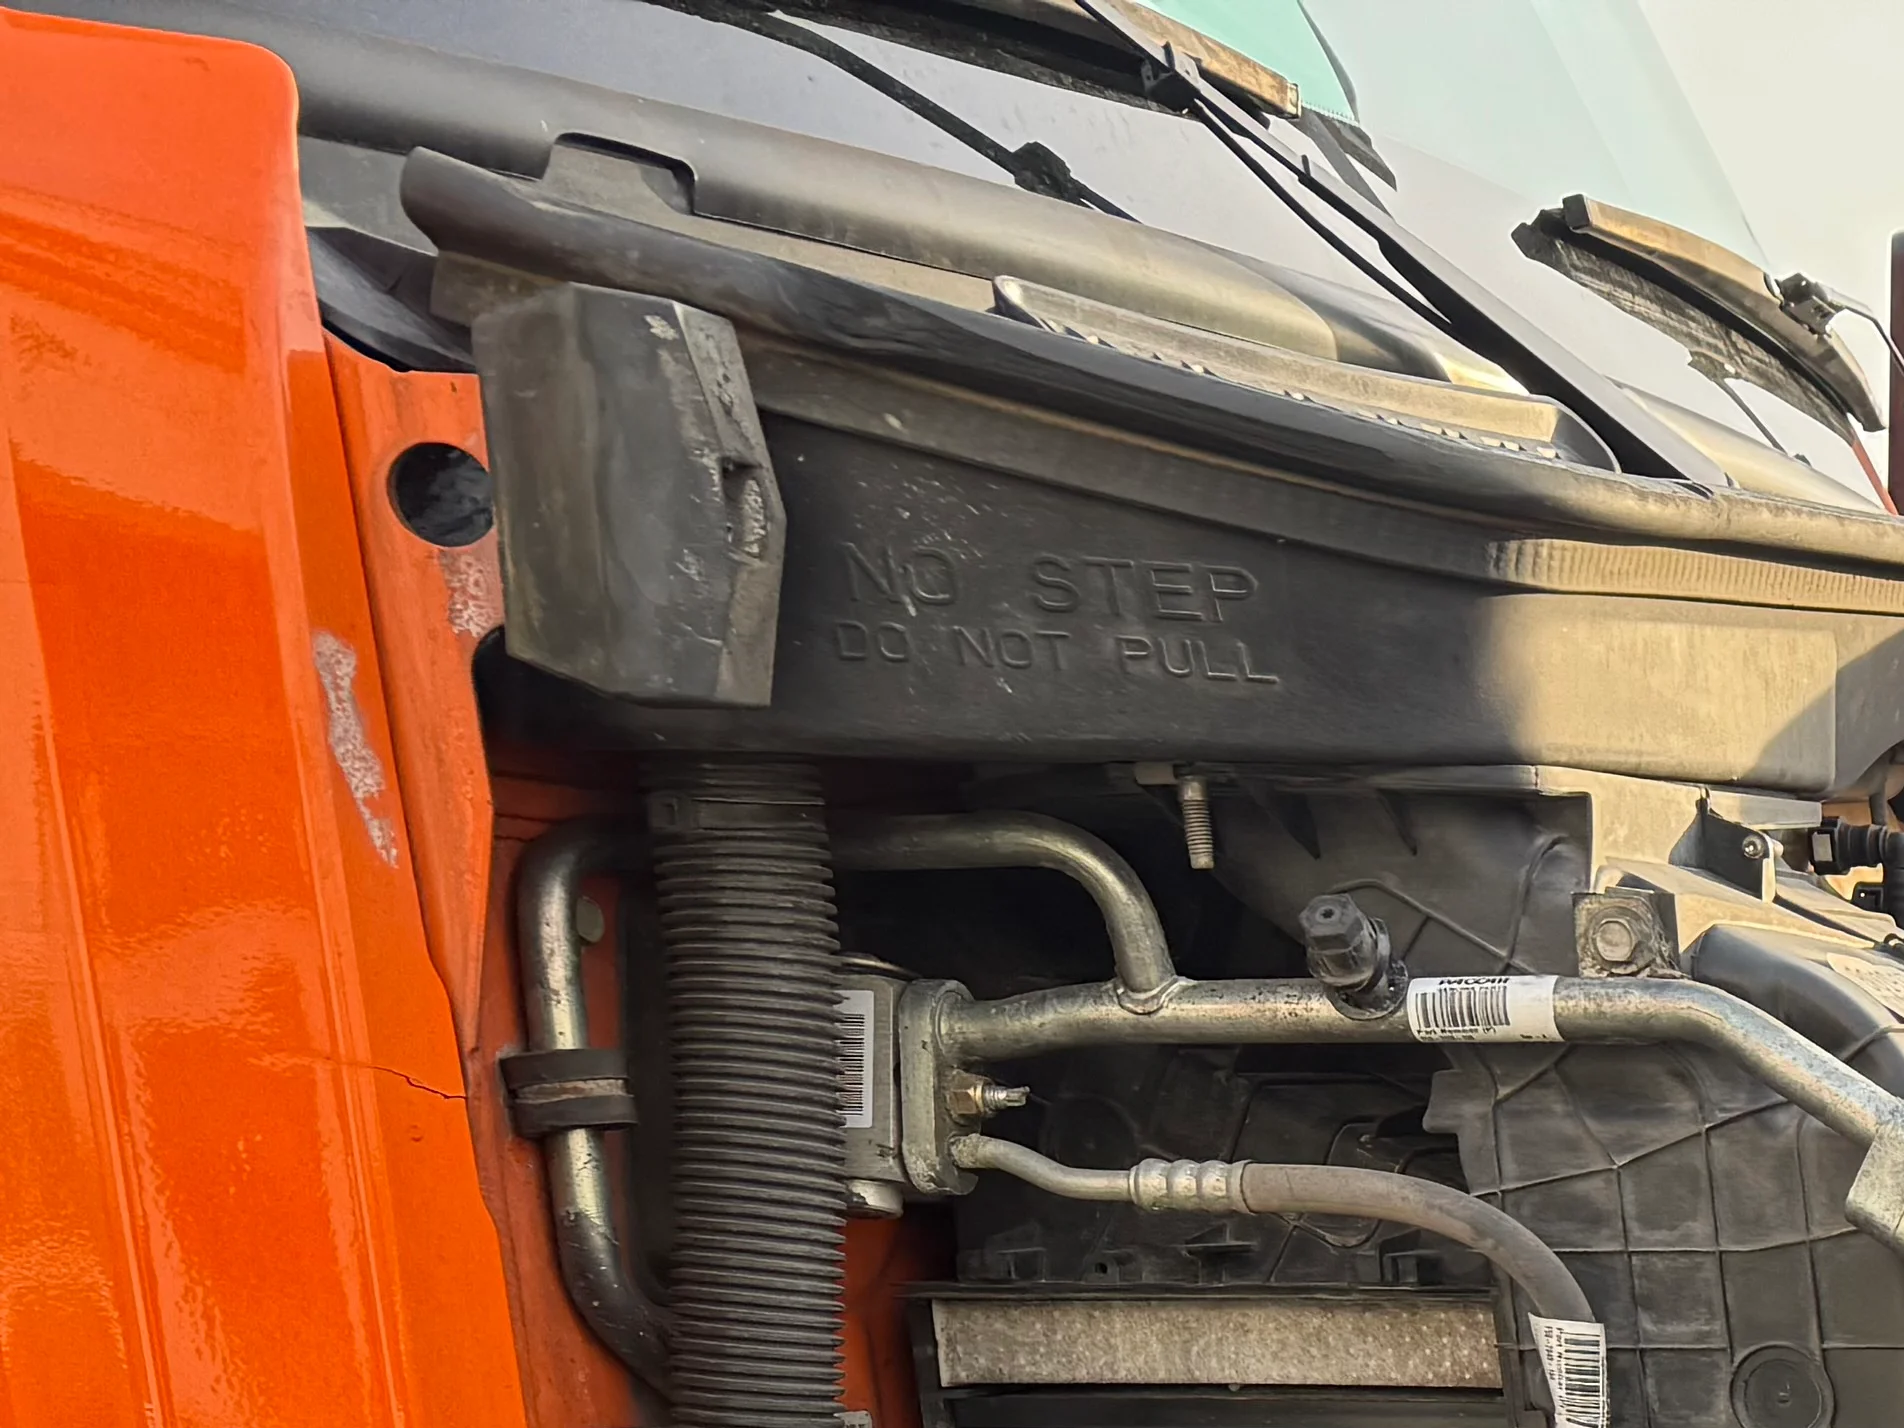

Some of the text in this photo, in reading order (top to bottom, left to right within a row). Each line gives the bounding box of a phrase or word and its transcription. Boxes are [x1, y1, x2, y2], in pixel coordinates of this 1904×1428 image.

[843, 542, 1259, 622] NO STEP
[835, 620, 1280, 683] DO NOT PULL
